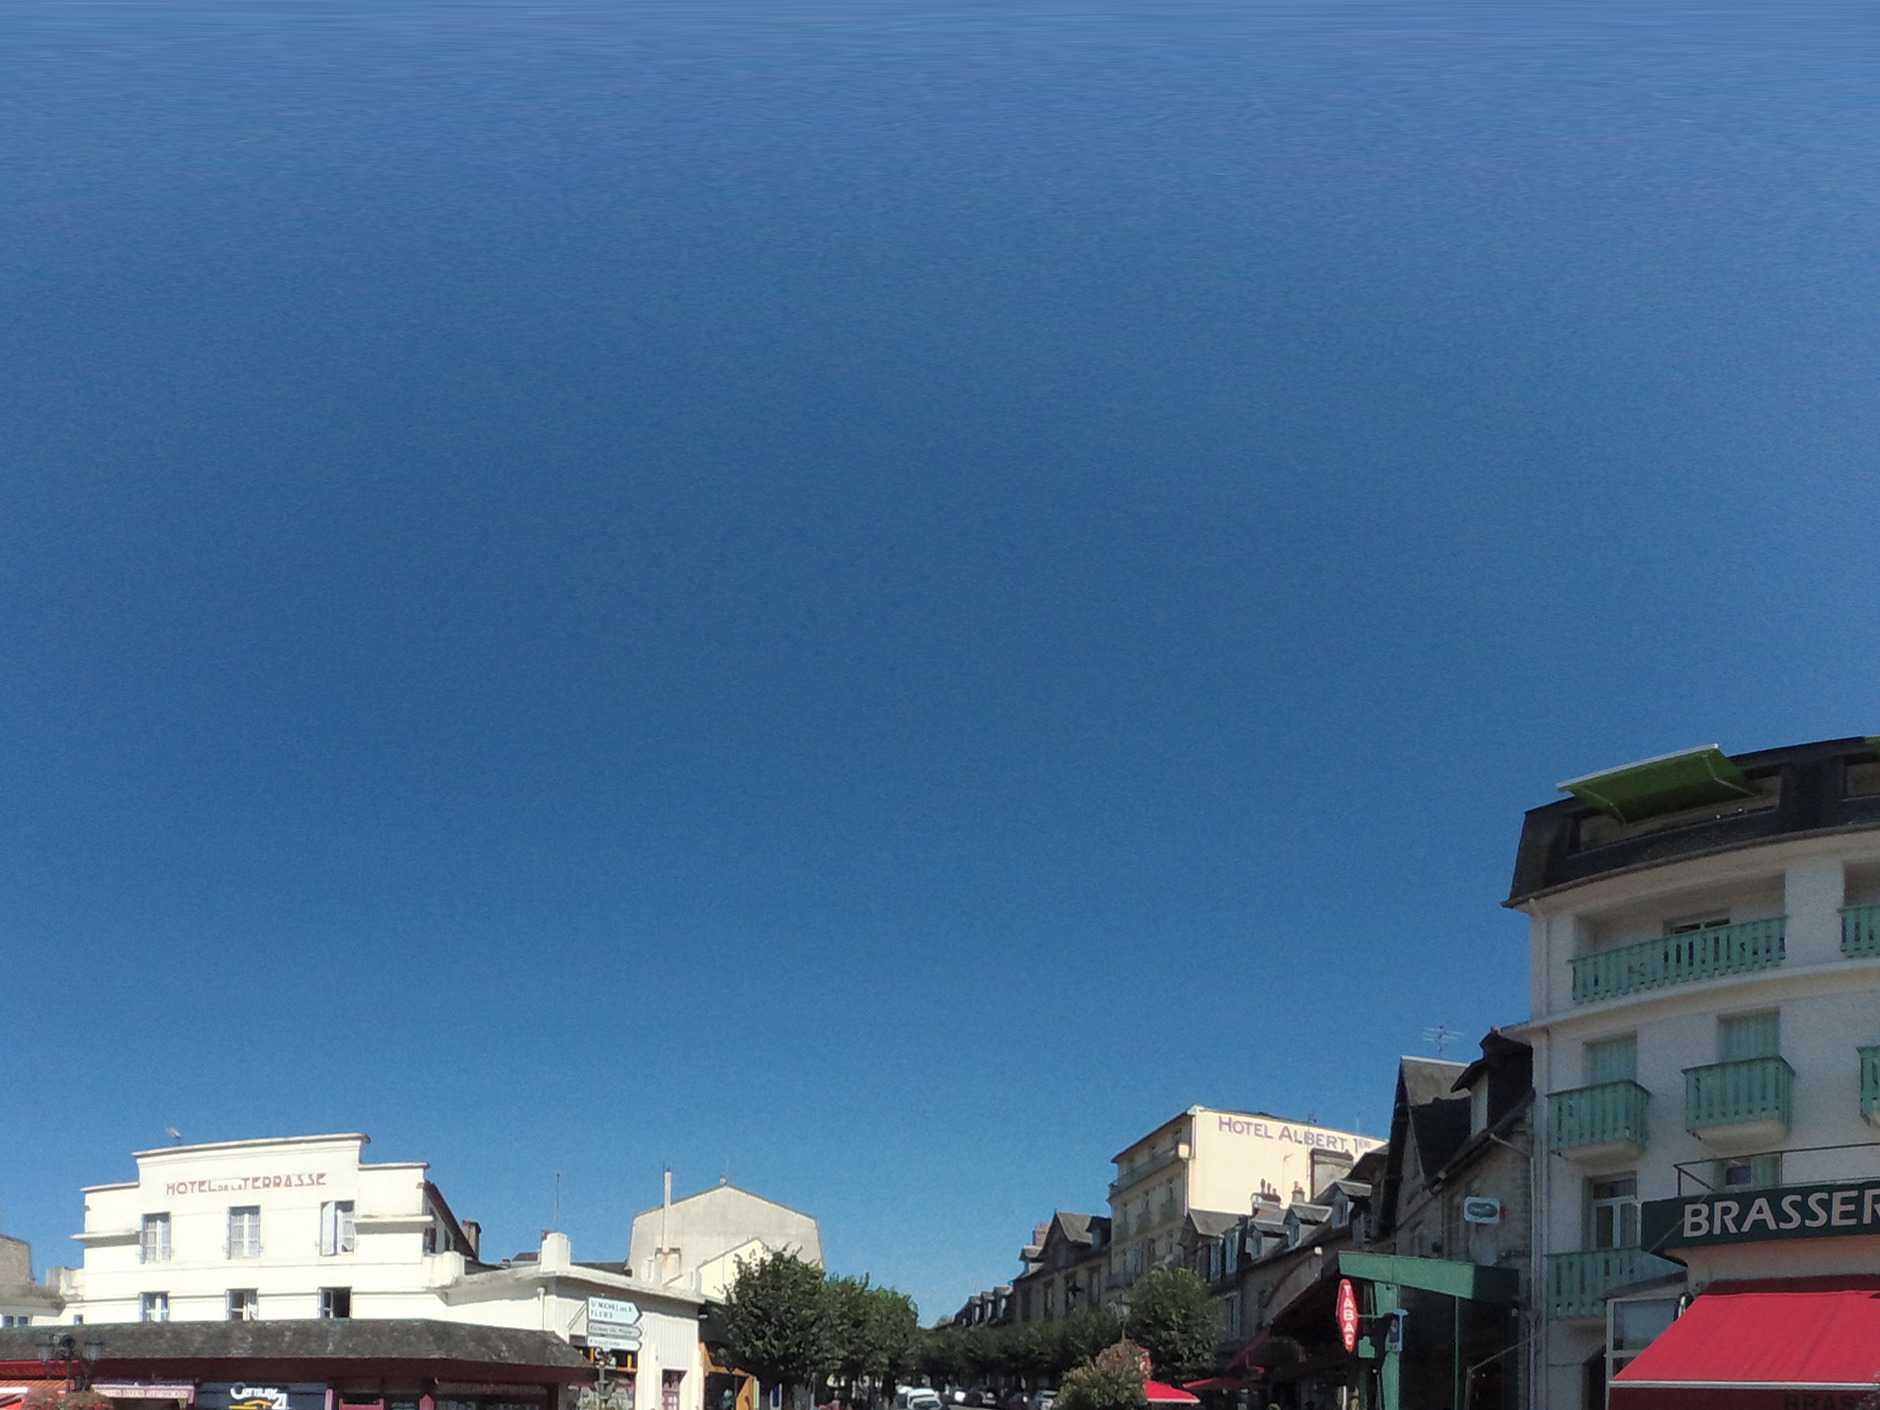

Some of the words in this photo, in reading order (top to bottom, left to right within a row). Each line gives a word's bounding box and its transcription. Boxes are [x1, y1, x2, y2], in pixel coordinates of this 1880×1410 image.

[1217, 1115, 1274, 1140] HOTEL
[1278, 1125, 1348, 1151] ALBERT
[166, 1179, 218, 1196] HOTEL
[241, 1172, 327, 1191] TERRASSE
[1342, 1284, 1355, 1346] TABAC
